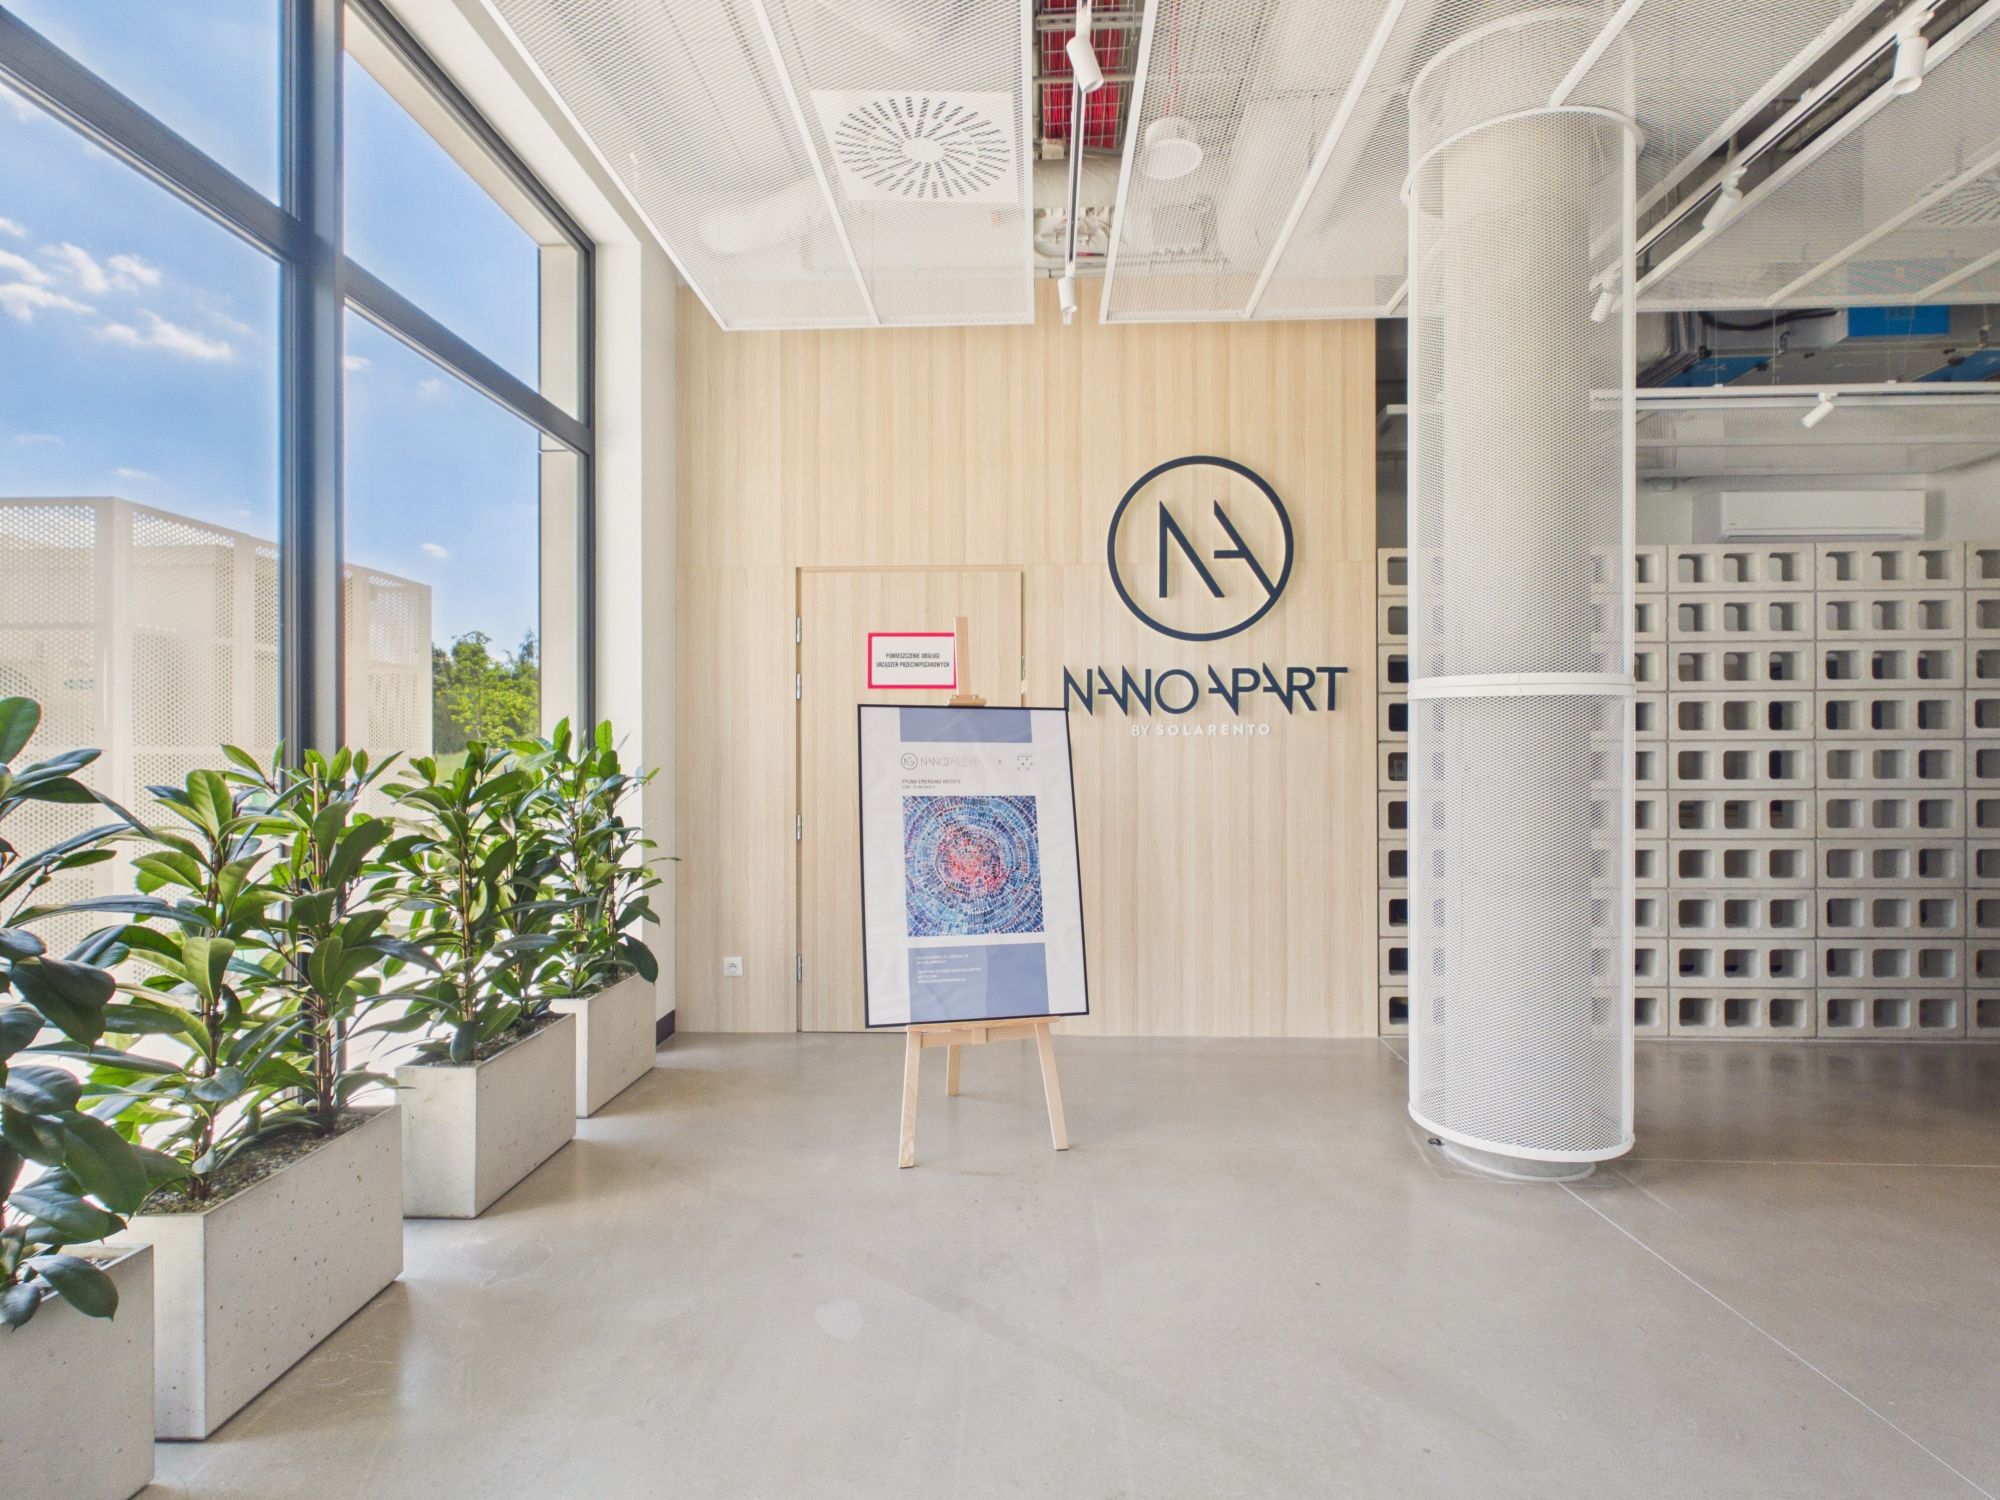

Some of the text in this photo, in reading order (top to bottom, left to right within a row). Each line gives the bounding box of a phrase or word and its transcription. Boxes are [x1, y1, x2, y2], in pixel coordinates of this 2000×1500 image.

[1063, 662, 1348, 717] NANO APART
[1131, 723, 1272, 737] BY SOLARENTO
